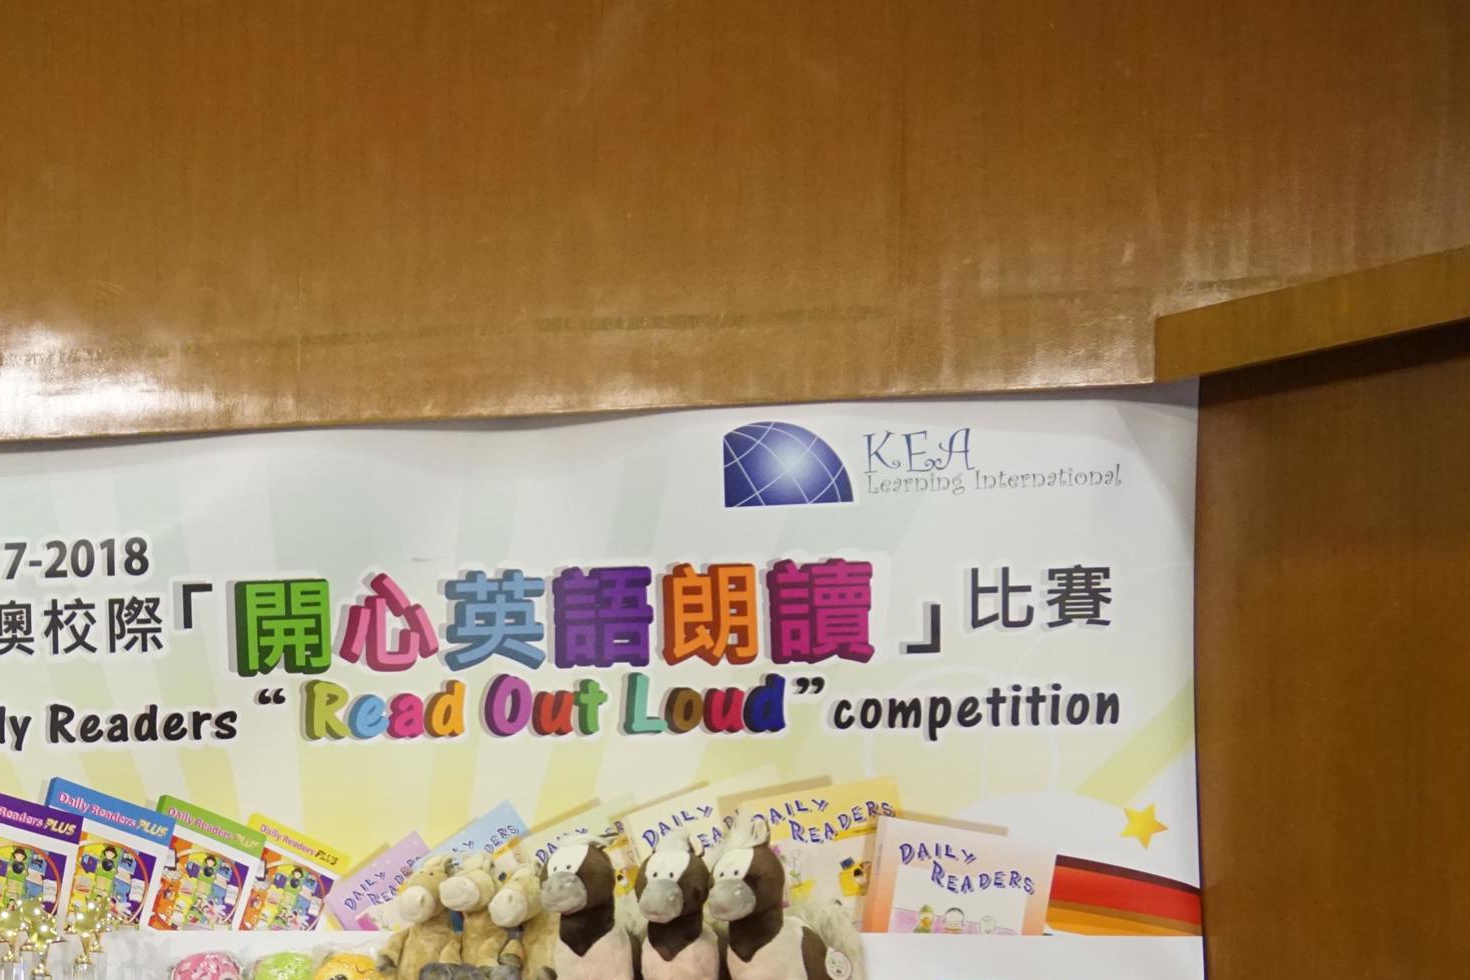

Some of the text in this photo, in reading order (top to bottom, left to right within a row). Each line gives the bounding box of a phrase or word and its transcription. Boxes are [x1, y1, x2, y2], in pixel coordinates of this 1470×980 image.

[863, 428, 975, 473] KEA
[866, 464, 1122, 495] Learning International
[46, 703, 238, 745] Readers
[481, 673, 609, 737] Out
[832, 683, 1120, 741] competition
[43, 817, 77, 837] PLUS
[57, 791, 90, 814] Daily
[136, 818, 170, 838] PLUS
[259, 823, 283, 841] Daily
[642, 805, 714, 848] DAILY
[789, 800, 896, 843] READERS
[899, 842, 977, 866] DAILY
[344, 871, 387, 911] DAILY
[931, 860, 1035, 896] READERS
